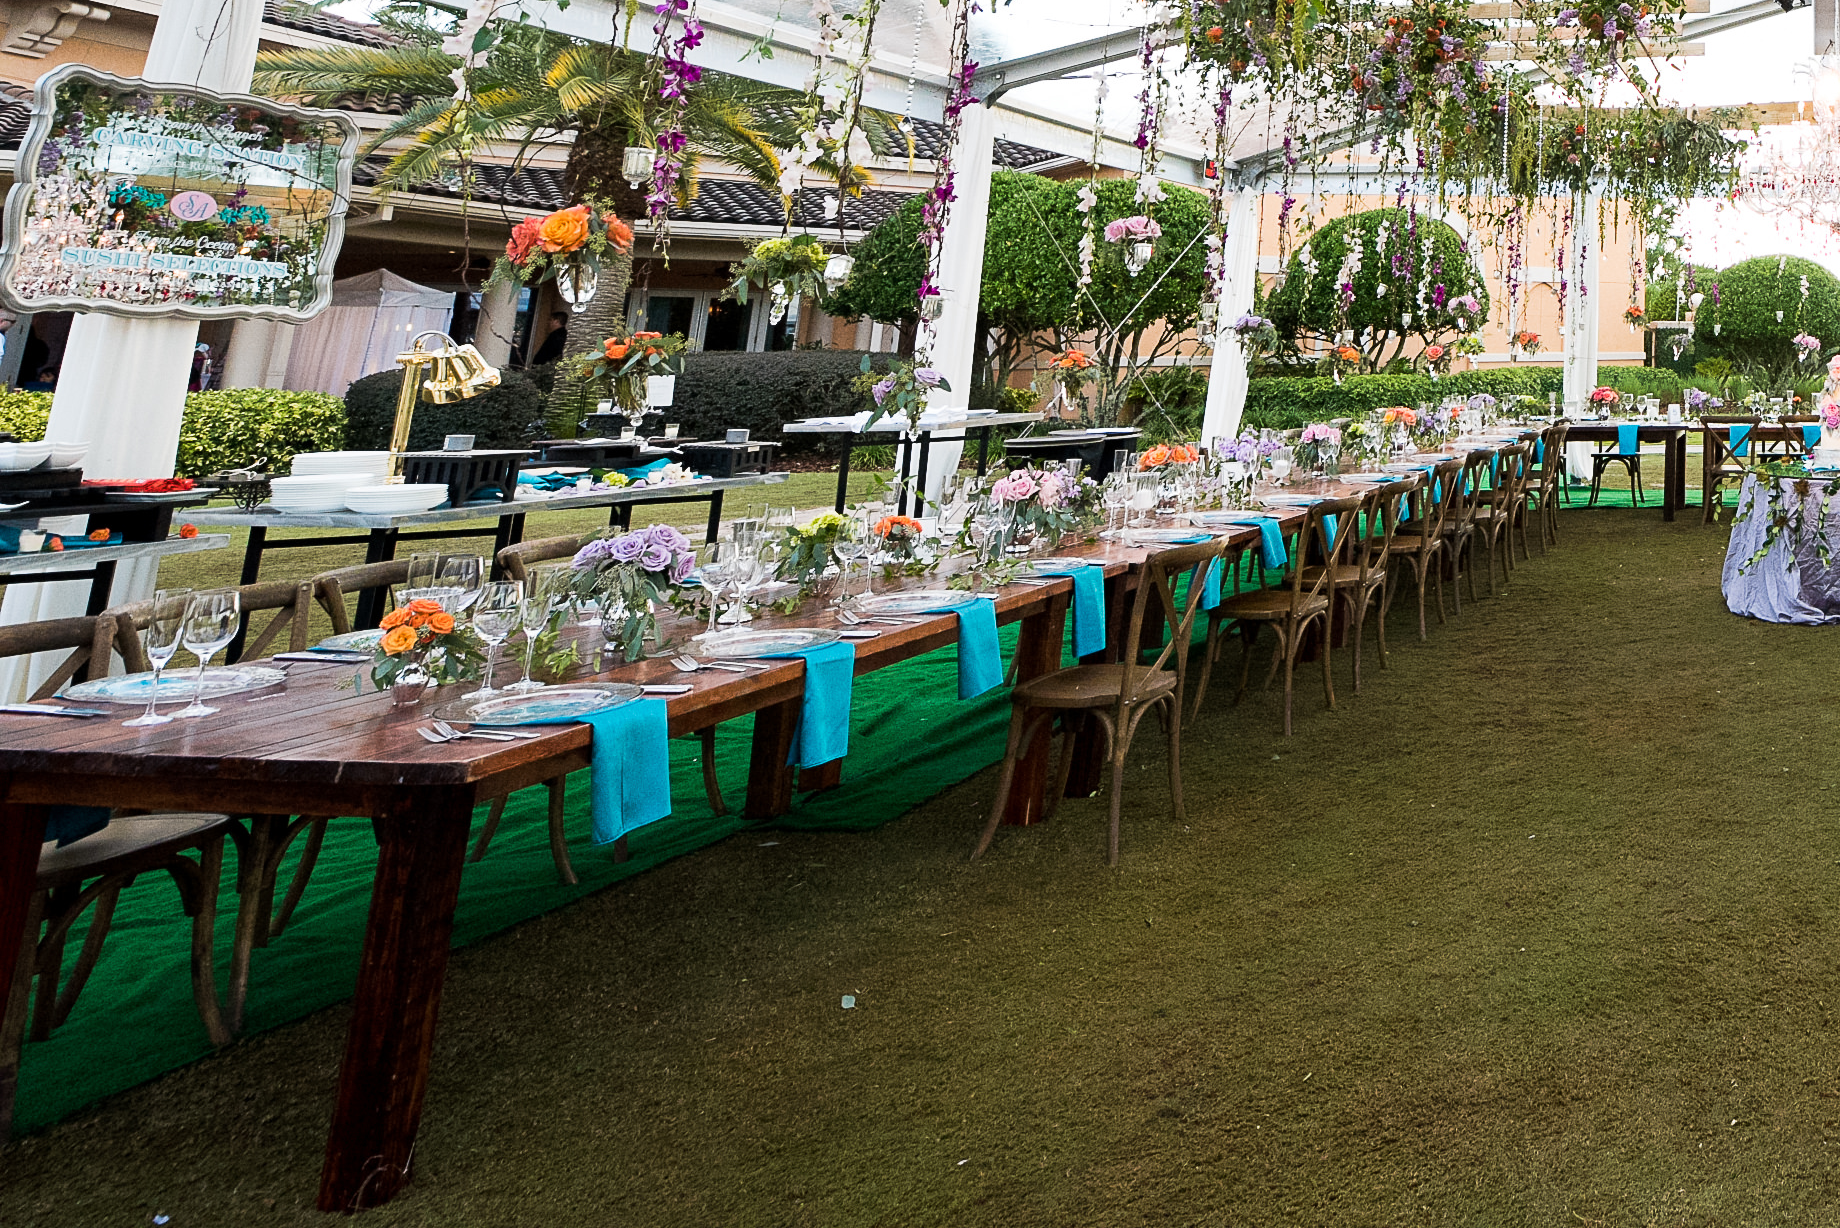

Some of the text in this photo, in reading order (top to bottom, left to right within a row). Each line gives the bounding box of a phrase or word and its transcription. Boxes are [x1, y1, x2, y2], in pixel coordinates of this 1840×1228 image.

[219, 123, 264, 142] Ranch
[93, 126, 205, 157] CARVING
[209, 142, 307, 171] STATION
[134, 230, 237, 252] From the Ocean
[61, 246, 289, 279] SUSHI SELECTIONS
